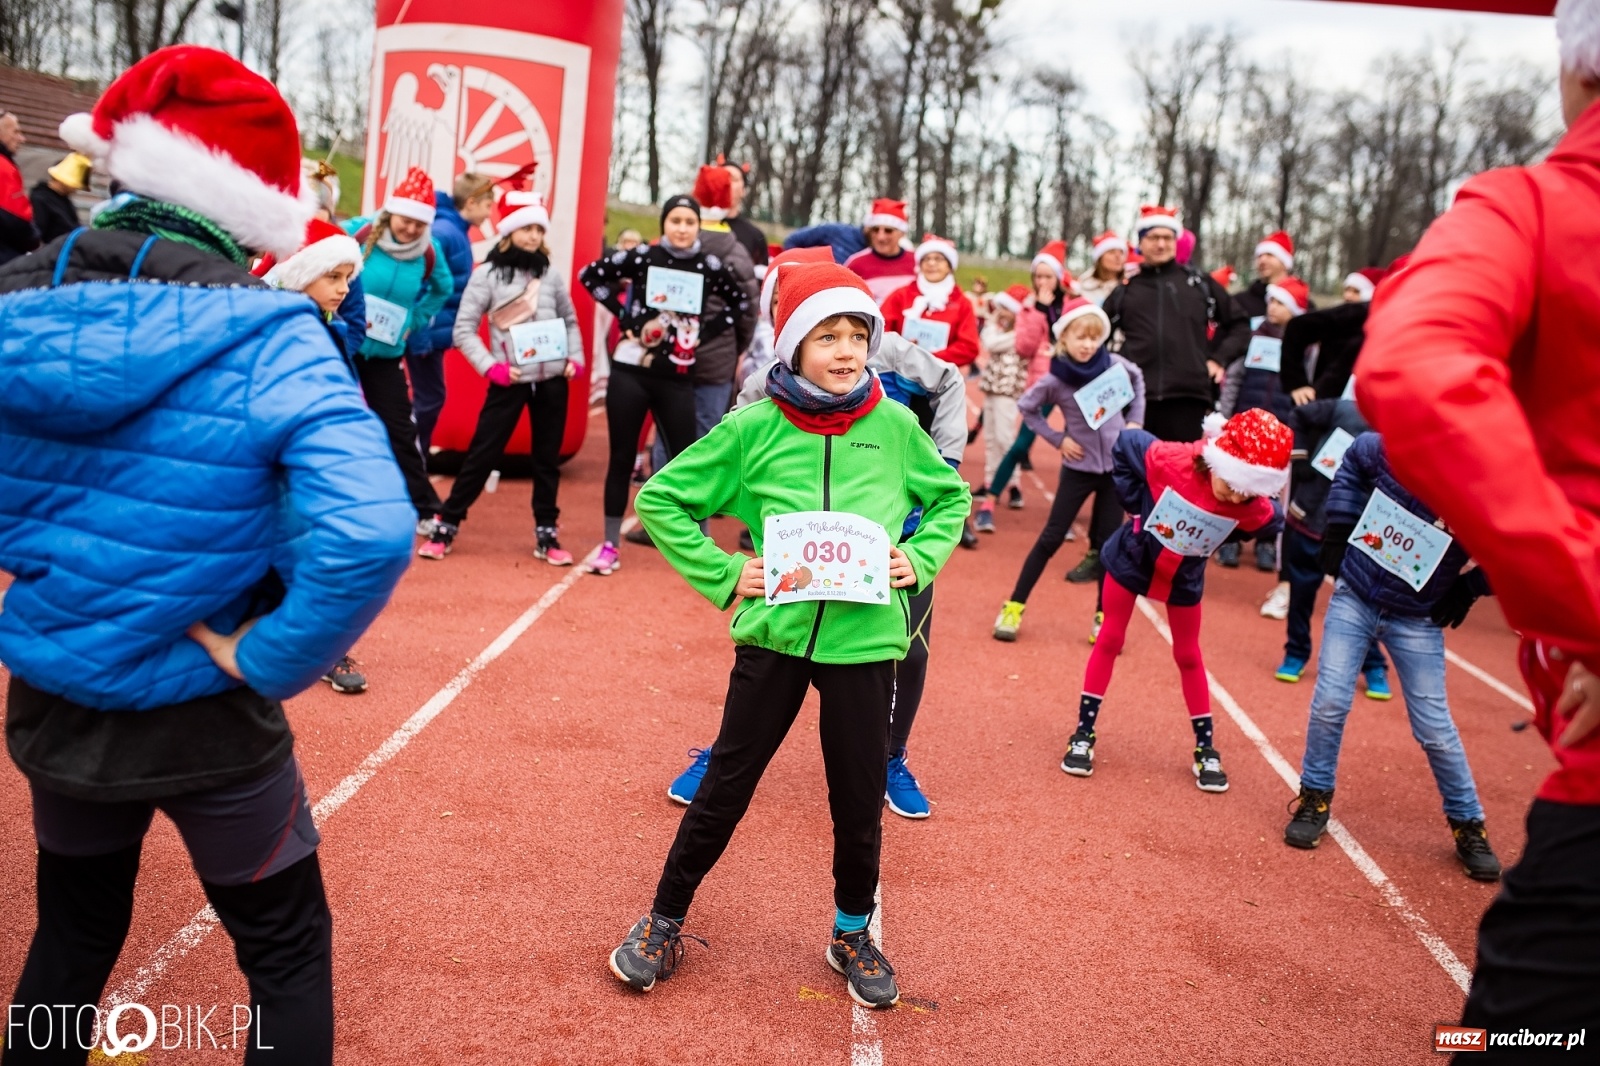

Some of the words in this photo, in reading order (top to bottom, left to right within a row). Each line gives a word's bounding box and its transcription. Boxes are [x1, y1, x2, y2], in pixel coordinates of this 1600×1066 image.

[777, 527, 804, 541] Bieg
[1176, 519, 1204, 540] 041
[1383, 525, 1415, 552] 060
[802, 540, 851, 564] 030
